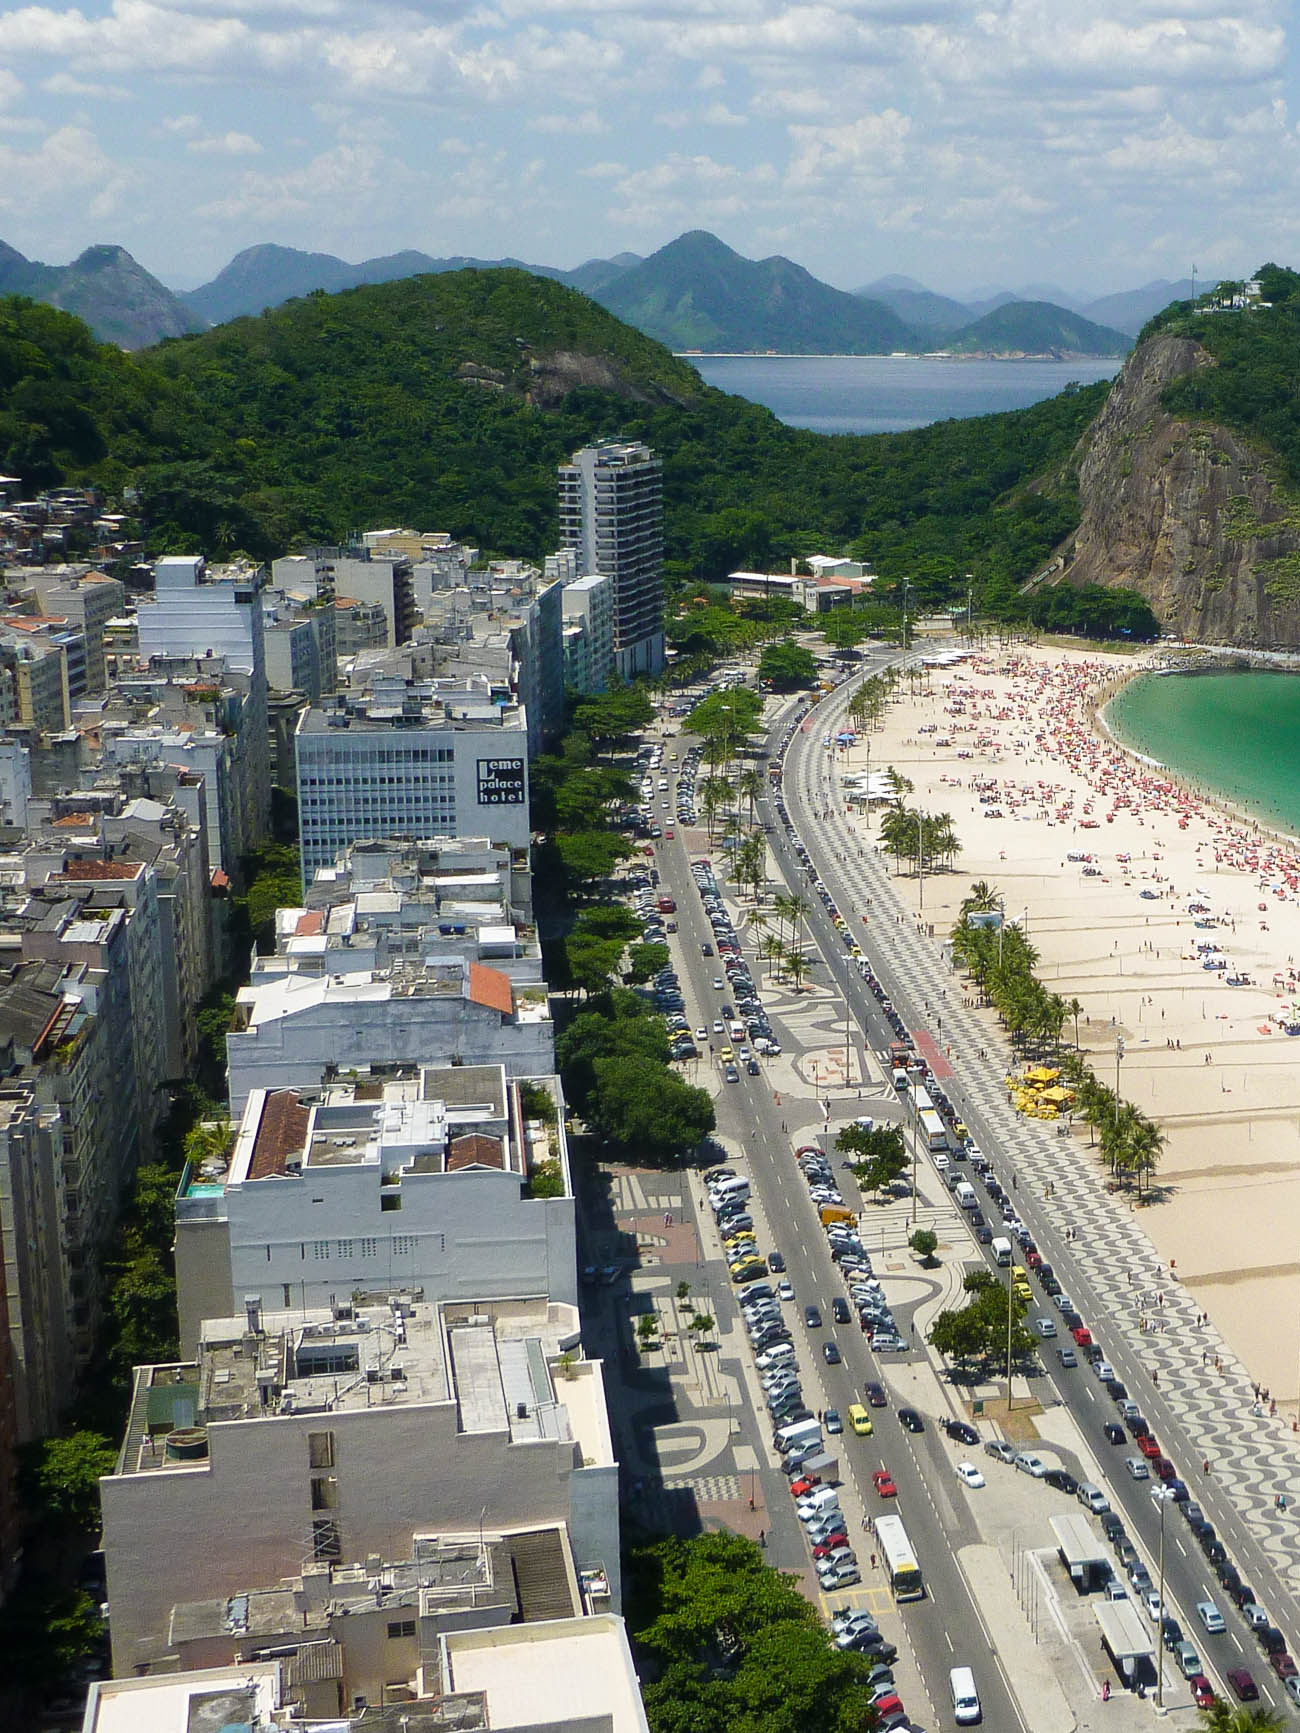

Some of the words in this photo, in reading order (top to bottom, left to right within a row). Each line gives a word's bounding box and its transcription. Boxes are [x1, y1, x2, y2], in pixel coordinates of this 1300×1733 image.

[479, 760, 521, 780] Leme
[480, 778, 522, 791] palace
[480, 791, 522, 802] hotel
